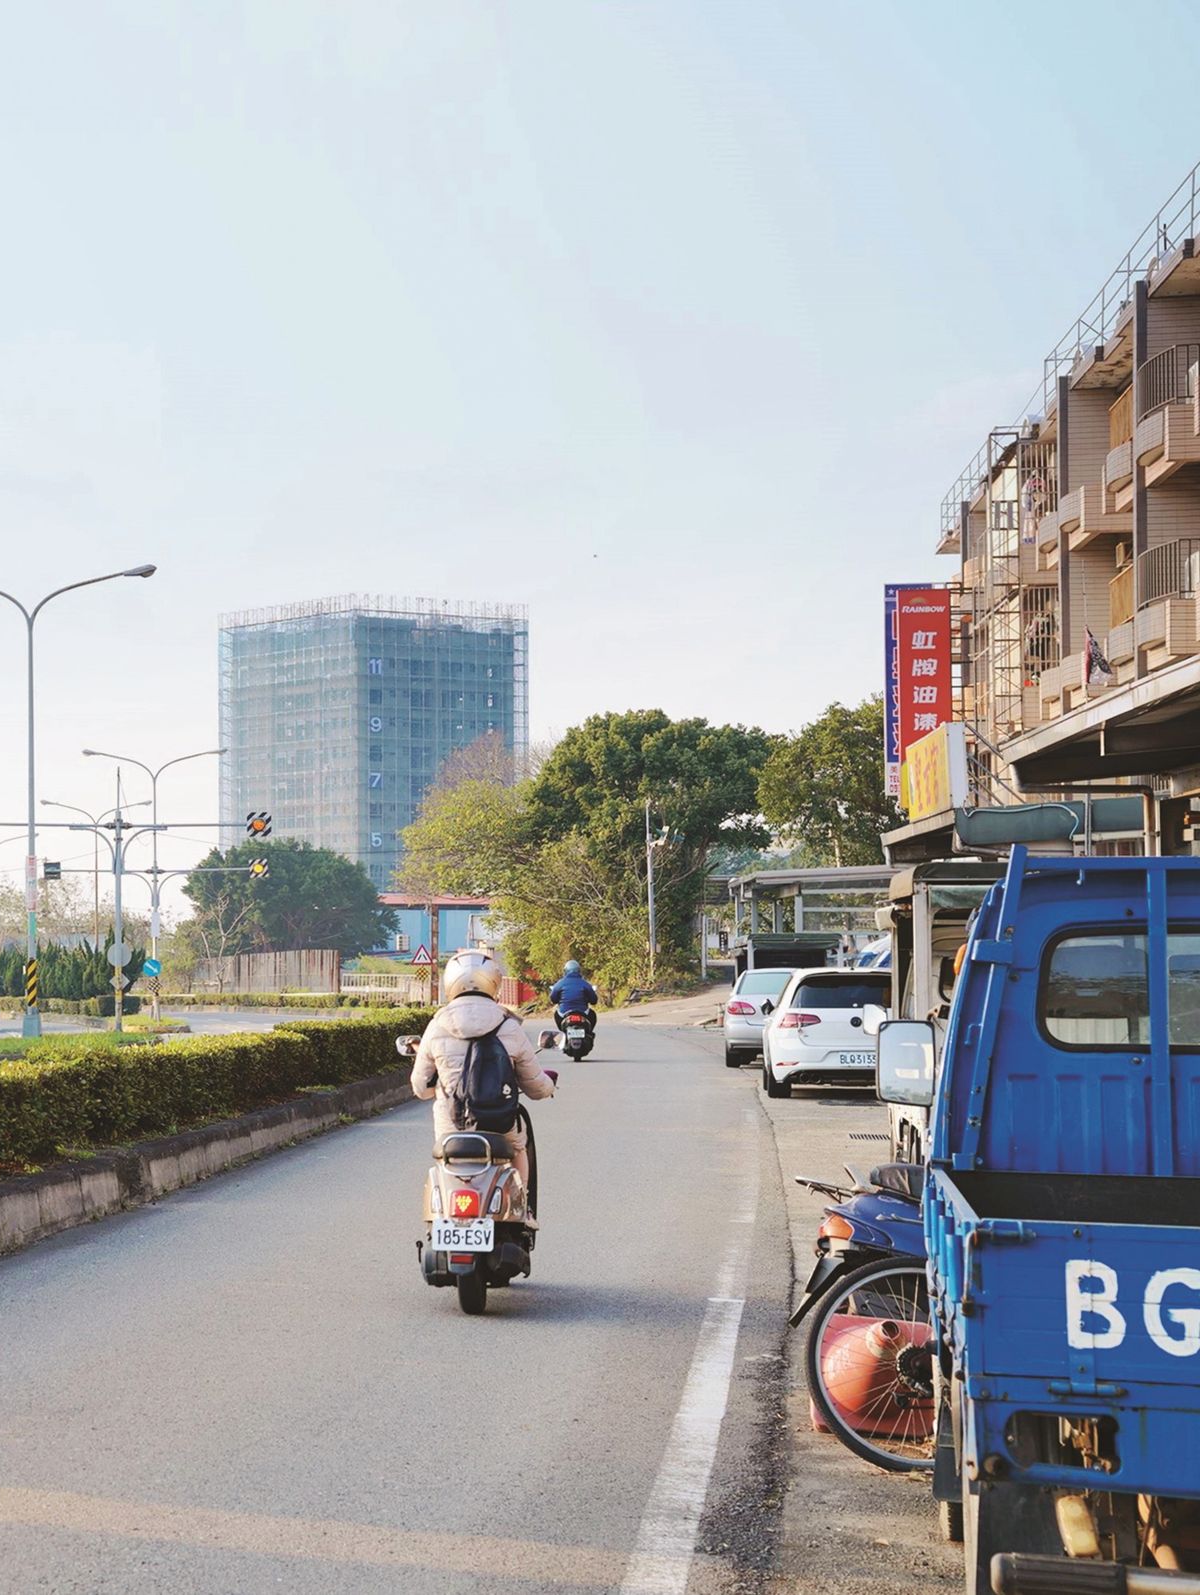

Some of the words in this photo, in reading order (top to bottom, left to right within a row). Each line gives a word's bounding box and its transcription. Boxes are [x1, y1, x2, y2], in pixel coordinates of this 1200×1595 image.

[902, 605, 946, 613] RAINBOW
[369, 659, 382, 674] 11
[911, 630, 938, 731] 虹牌油漆
[370, 717, 382, 732] 9
[370, 773, 382, 788] 7
[371, 832, 382, 848] 5
